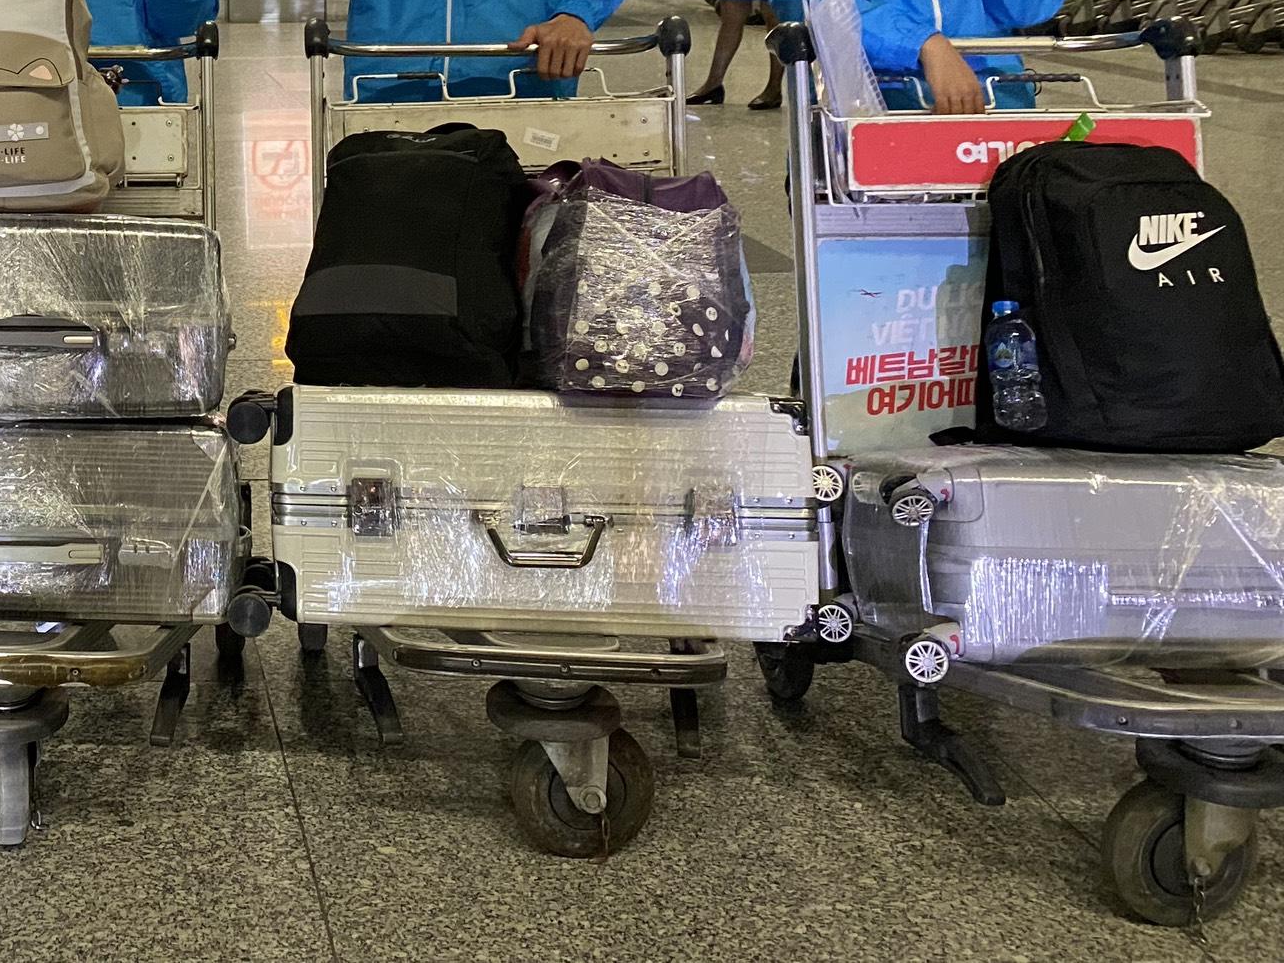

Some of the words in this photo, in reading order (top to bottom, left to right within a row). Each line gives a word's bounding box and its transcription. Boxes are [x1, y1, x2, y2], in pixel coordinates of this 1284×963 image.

[1138, 212, 1198, 246] NIKE
[1158, 267, 1225, 288] AIR
[897, 283, 936, 312] DU
